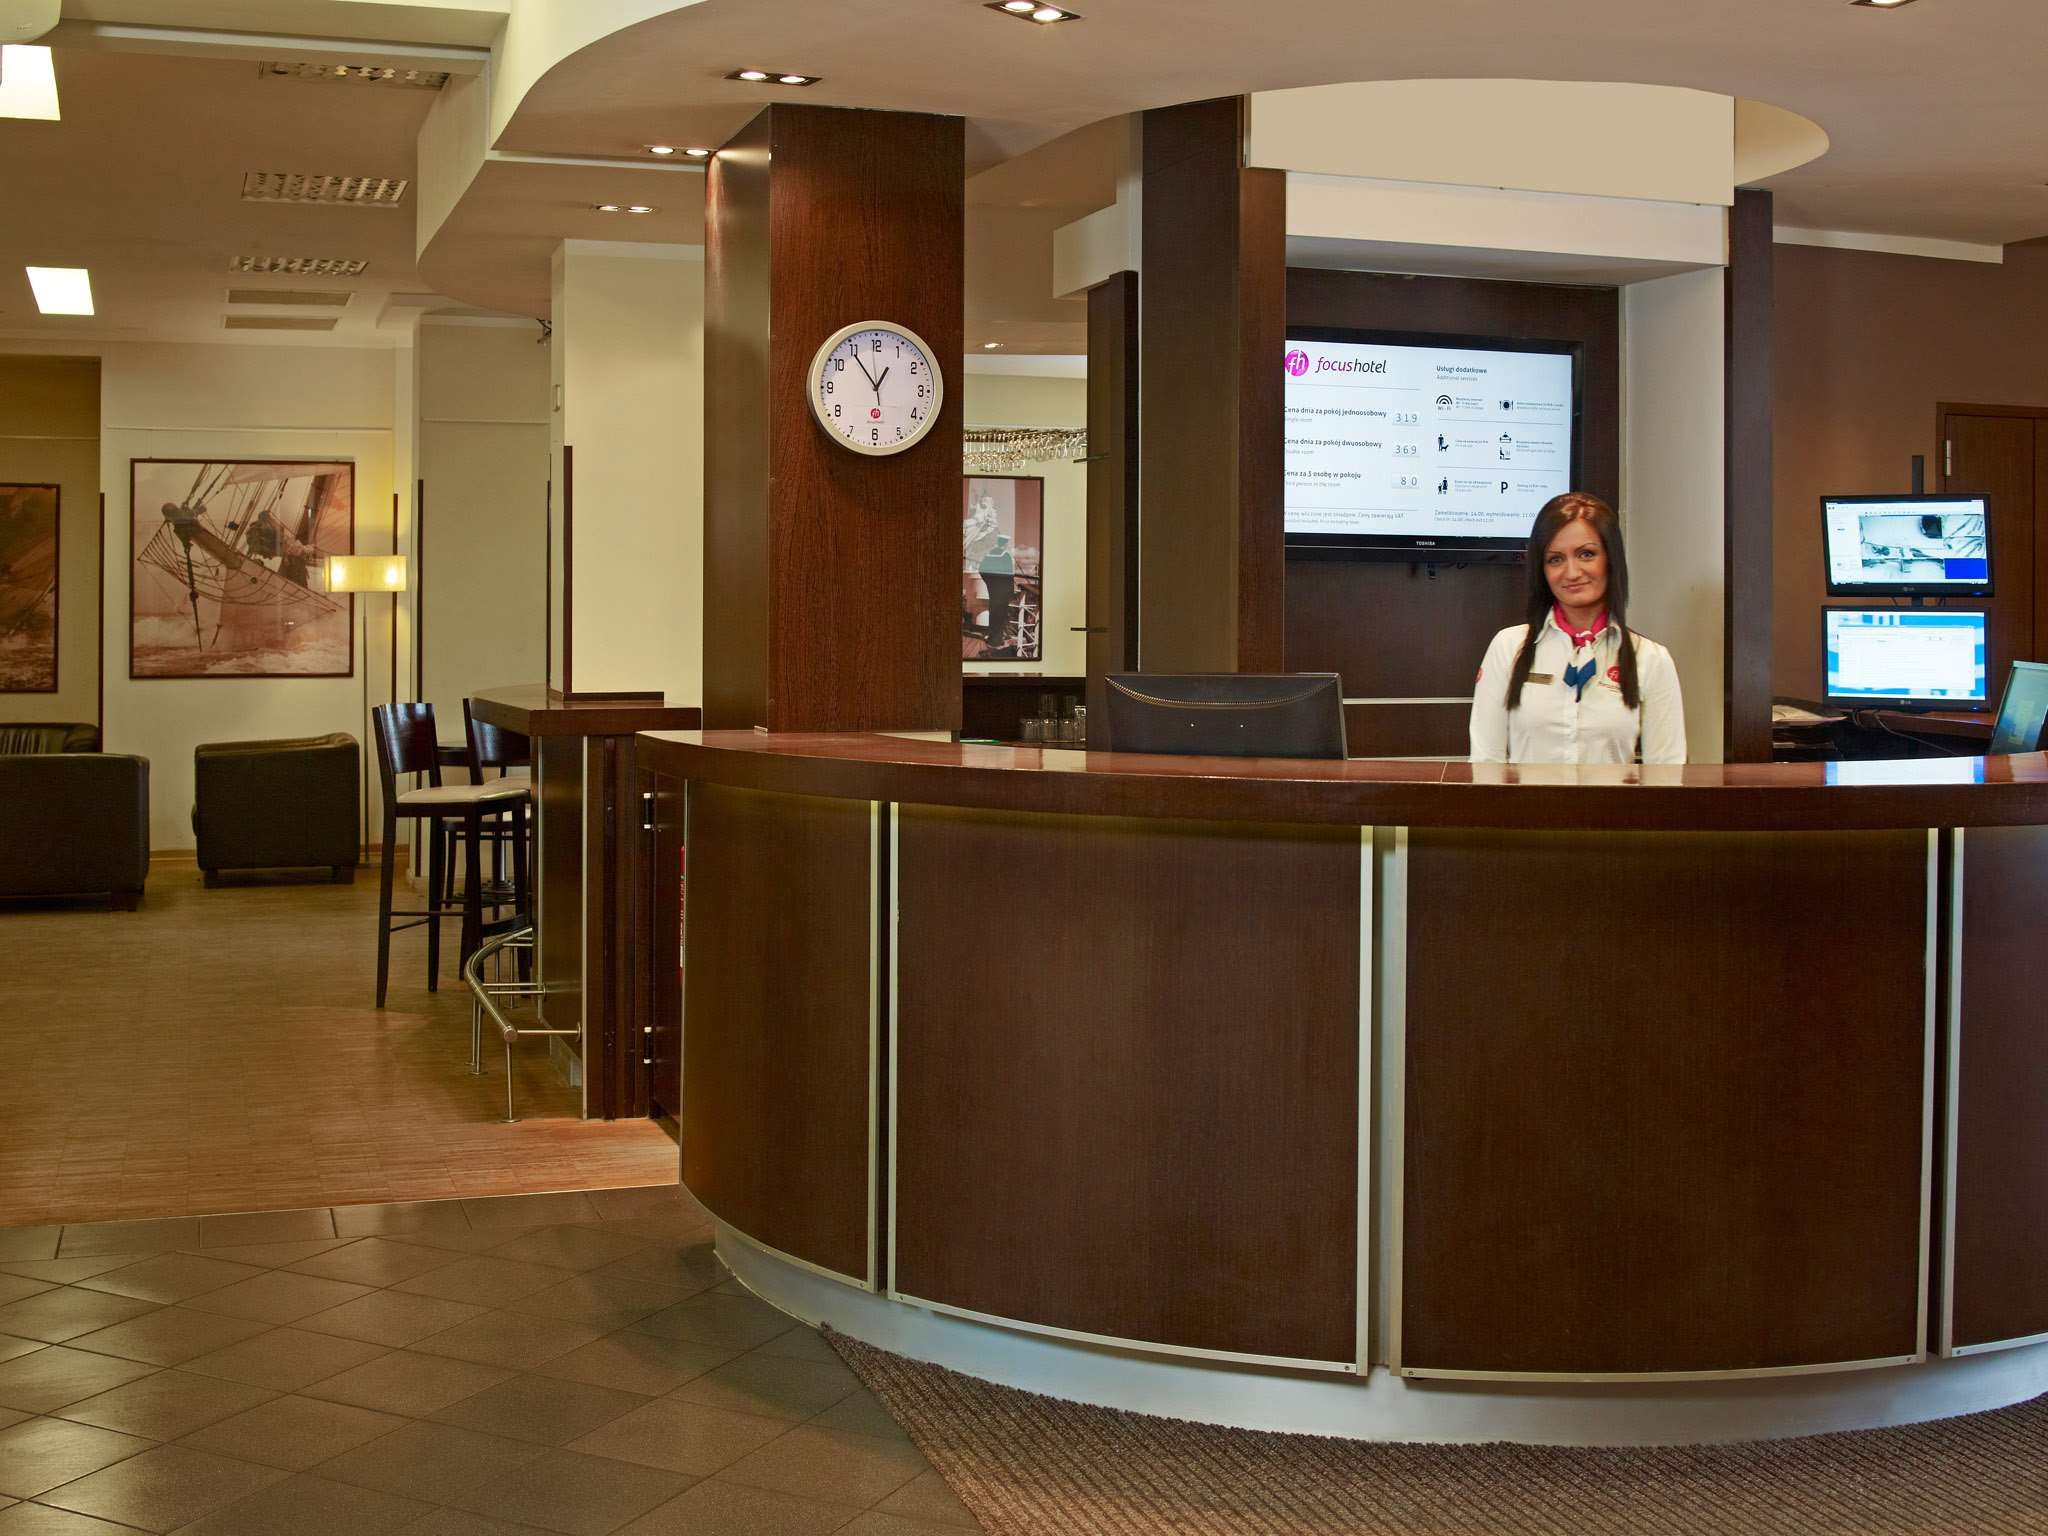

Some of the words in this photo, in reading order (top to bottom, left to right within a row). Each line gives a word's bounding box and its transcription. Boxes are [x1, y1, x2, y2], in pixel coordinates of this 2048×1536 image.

[849, 344, 858, 357] 11
[872, 340, 882, 352] 12
[896, 346, 900, 359] 1
[833, 359, 845, 371] 10
[910, 362, 917, 375] 2
[1455, 366, 1488, 374] dodatkowe
[826, 381, 834, 394] 9
[917, 385, 924, 397] 3
[834, 405, 841, 417] 8
[910, 407, 917, 420] 4
[1300, 406, 1314, 414] dnia
[1323, 407, 1341, 416] pokój
[1342, 408, 1387, 418] jednoosobowy
[849, 425, 854, 434] 7
[871, 428, 878, 441] 6
[896, 427, 901, 436] 5
[1323, 439, 1341, 447] pokój
[1341, 439, 1383, 448] dwuosobowy
[1313, 470, 1332, 478] osobę
[1340, 471, 1361, 479] pokoju
